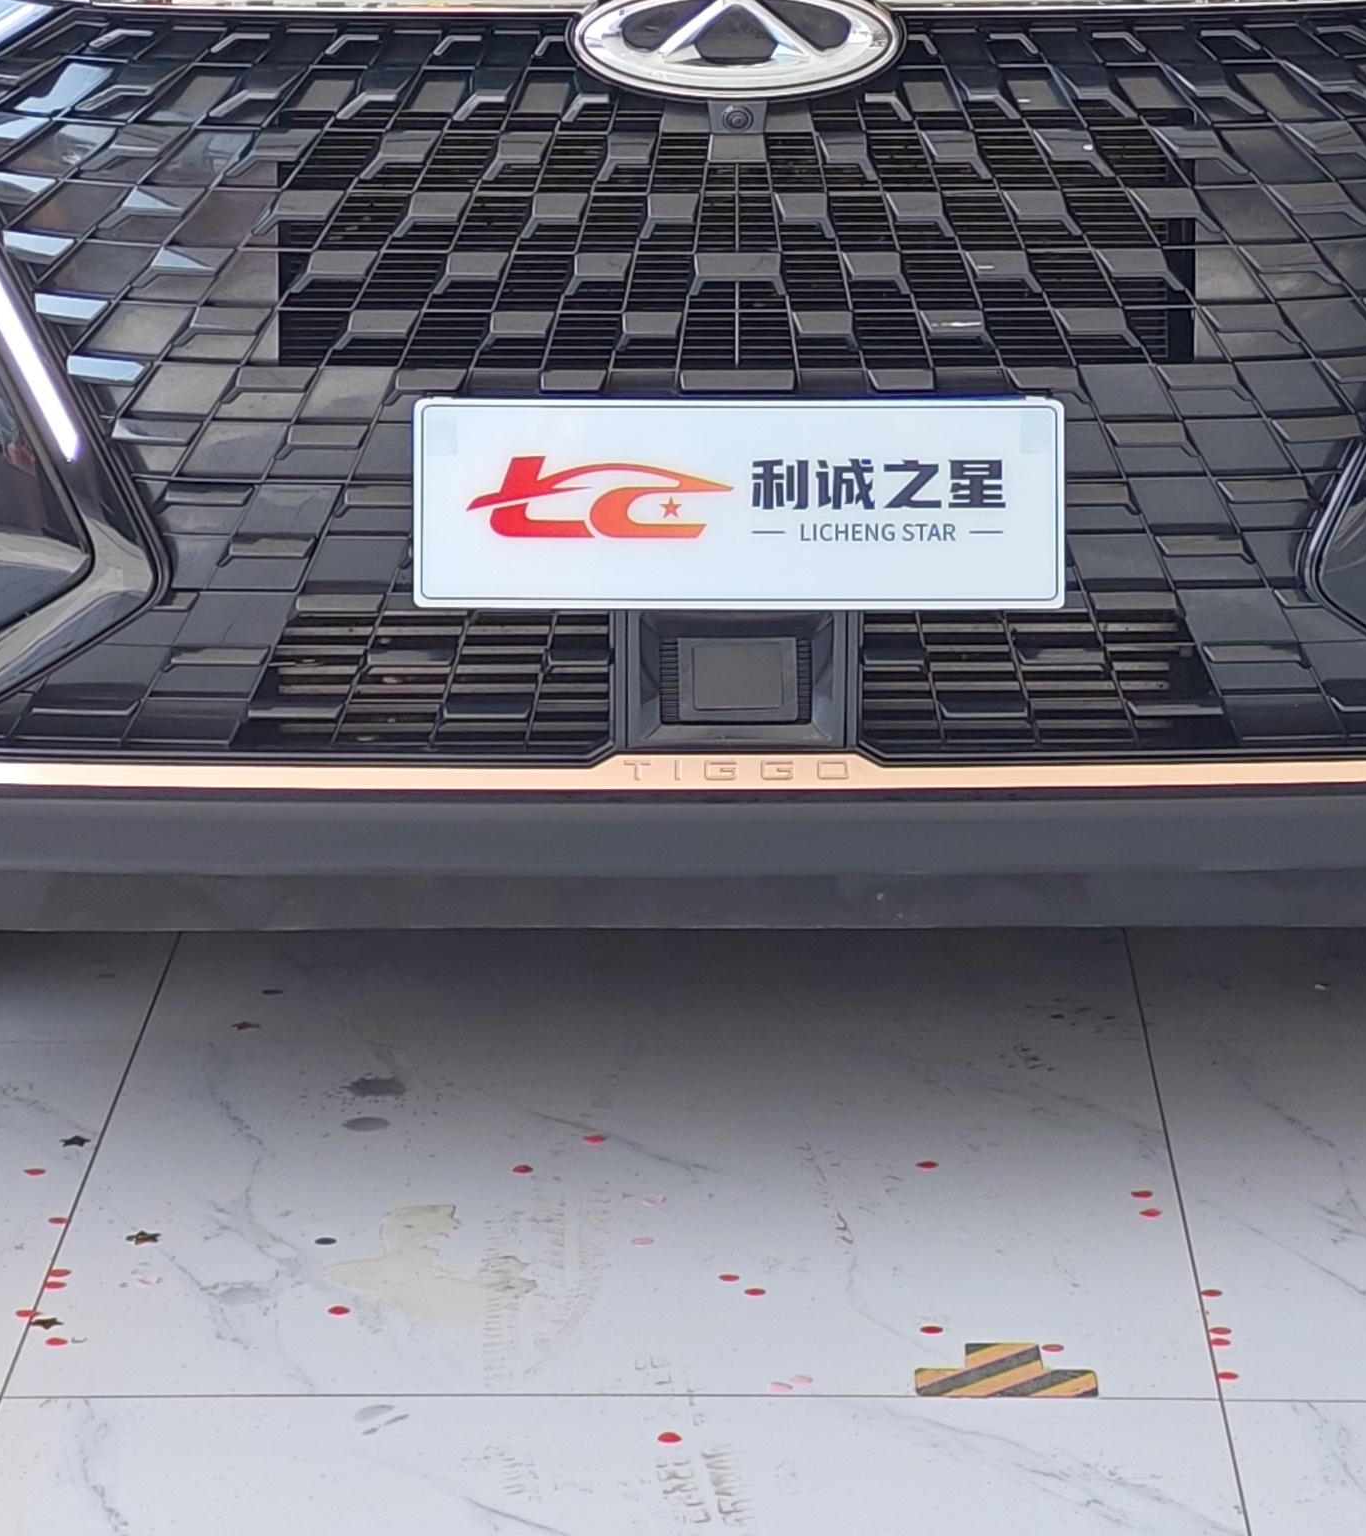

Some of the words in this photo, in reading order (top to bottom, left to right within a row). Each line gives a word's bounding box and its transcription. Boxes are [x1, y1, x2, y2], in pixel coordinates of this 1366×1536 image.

[752, 458, 1006, 510] 利诚之星
[800, 522, 896, 542] LICHENG
[901, 522, 956, 542] STAR
[623, 758, 850, 782] TIGGO
